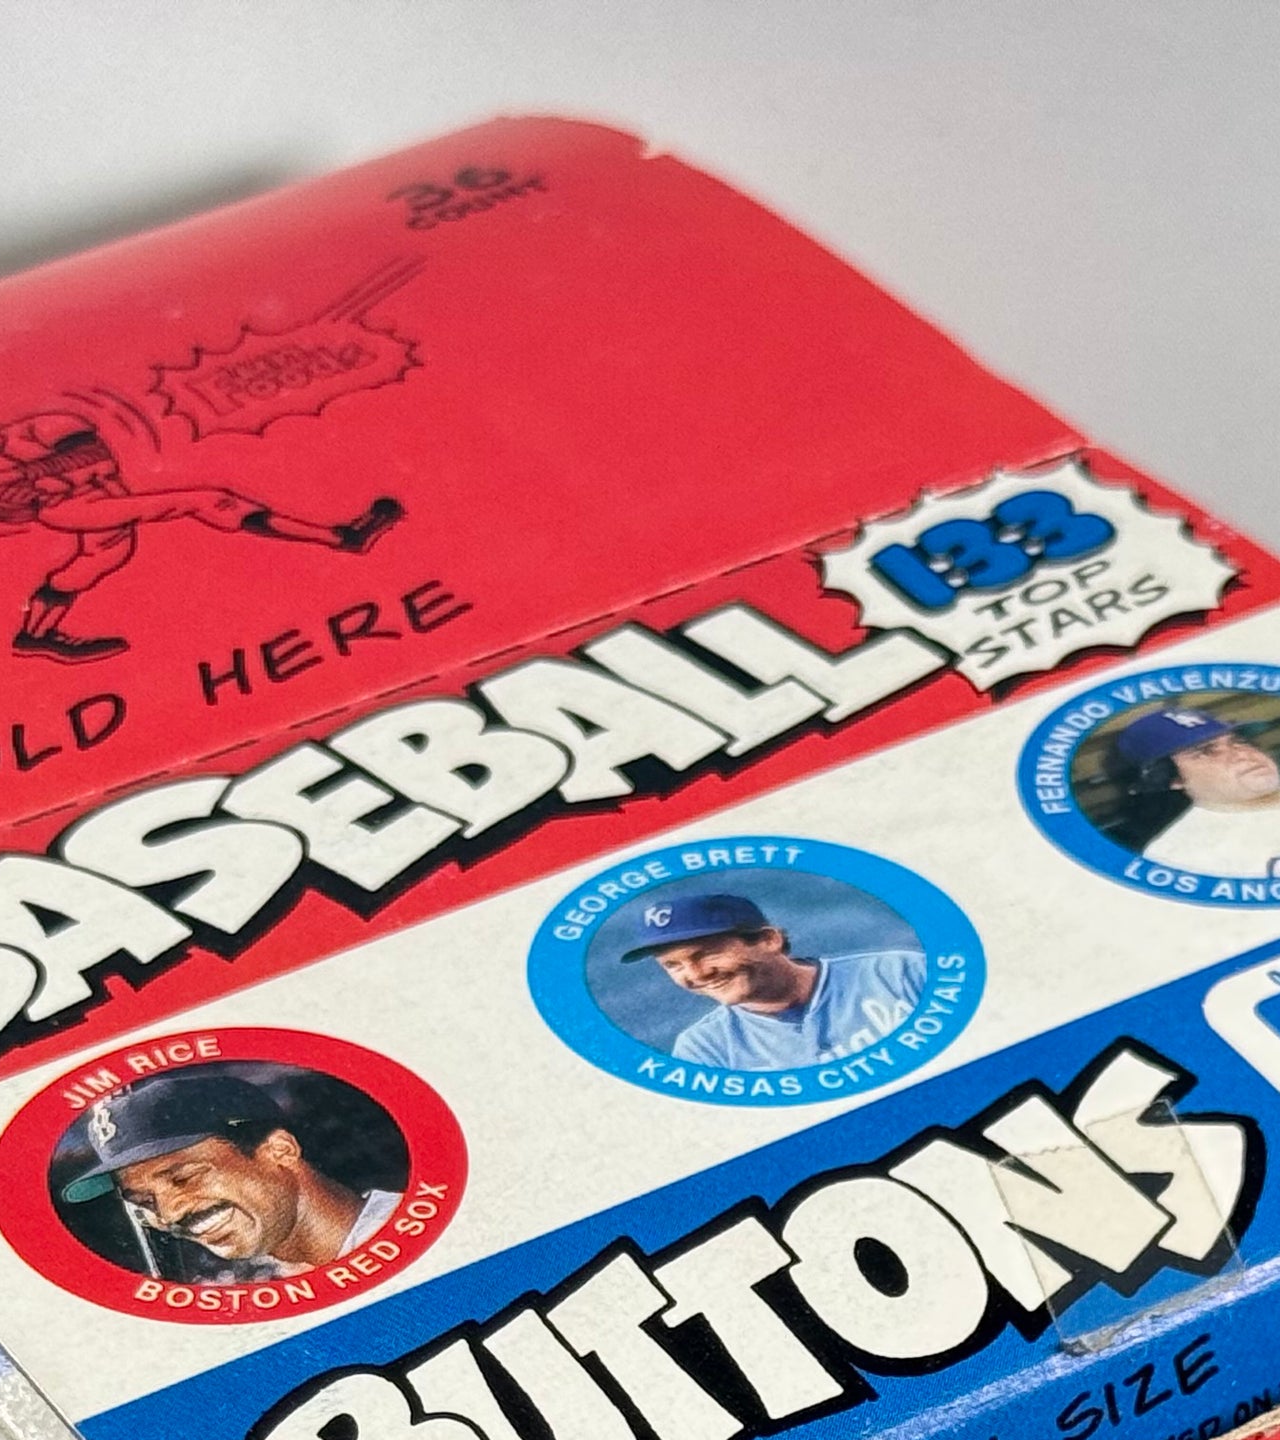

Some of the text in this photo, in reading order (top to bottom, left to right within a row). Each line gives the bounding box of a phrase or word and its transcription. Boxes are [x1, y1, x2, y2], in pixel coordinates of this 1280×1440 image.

[869, 489, 1118, 613] 133
[973, 559, 1113, 622] TOP
[197, 579, 473, 705] HERE
[957, 573, 1171, 673] STARS
[1036, 699, 1115, 815] FERNANDO
[553, 844, 805, 942] GEORGE BRETT
[1124, 857, 1199, 895] LOS
[60, 1036, 222, 1110] JIM RICE
[637, 1056, 804, 1097] KANSAS
[817, 1045, 895, 1091] CITY
[900, 953, 966, 1052] ROYALS
[133, 1180, 450, 1312] BOSTON RED SOX
